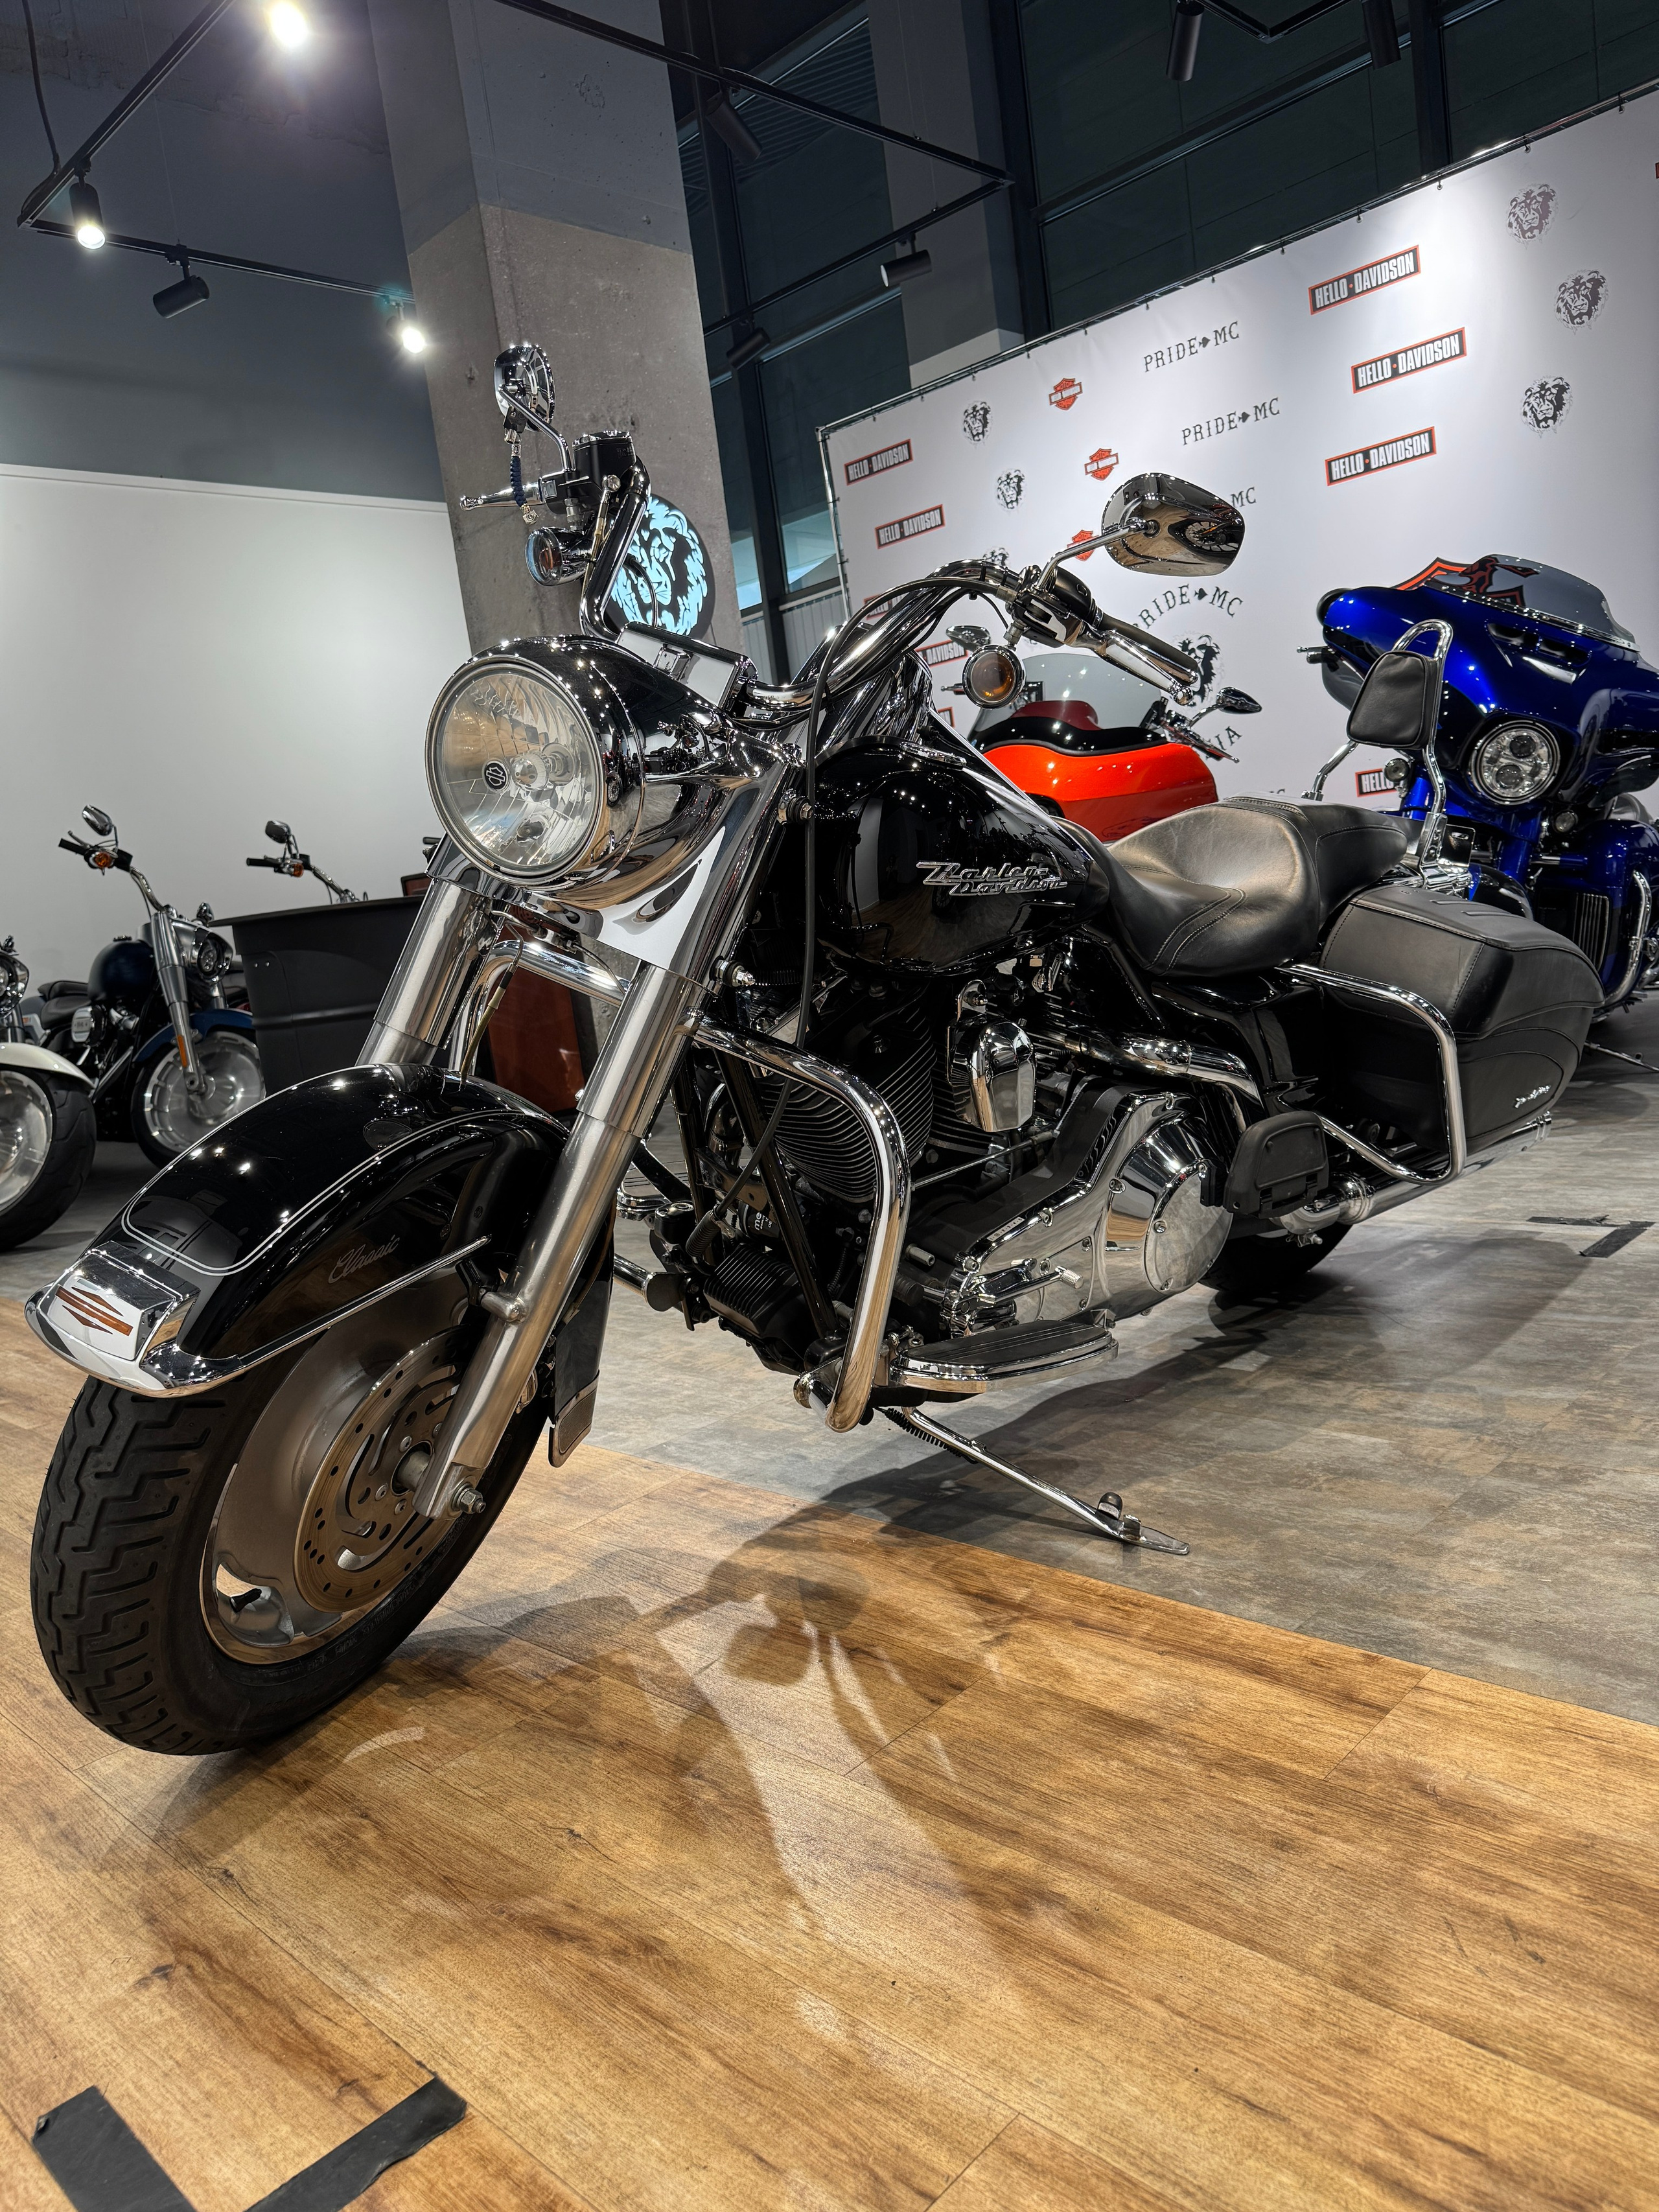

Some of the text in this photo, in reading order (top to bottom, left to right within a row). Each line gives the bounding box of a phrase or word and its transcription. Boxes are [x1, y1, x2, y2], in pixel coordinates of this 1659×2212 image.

[1314, 251, 1415, 309] HELLO DAVIDSON
[1143, 321, 1240, 373] PRIDE MC
[1357, 334, 1460, 388] HELLO DAVIDSON
[1181, 397, 1280, 446] PRIDE MC
[848, 444, 909, 481] HELLO DAVIDSON
[1330, 432, 1430, 481] HELLO DAVIDSON
[1231, 487, 1257, 507] MC
[878, 509, 942, 544] HELLO DAVIDSON
[1132, 584, 1243, 629] RIDE MC
[328, 1234, 400, 1284] Classic
